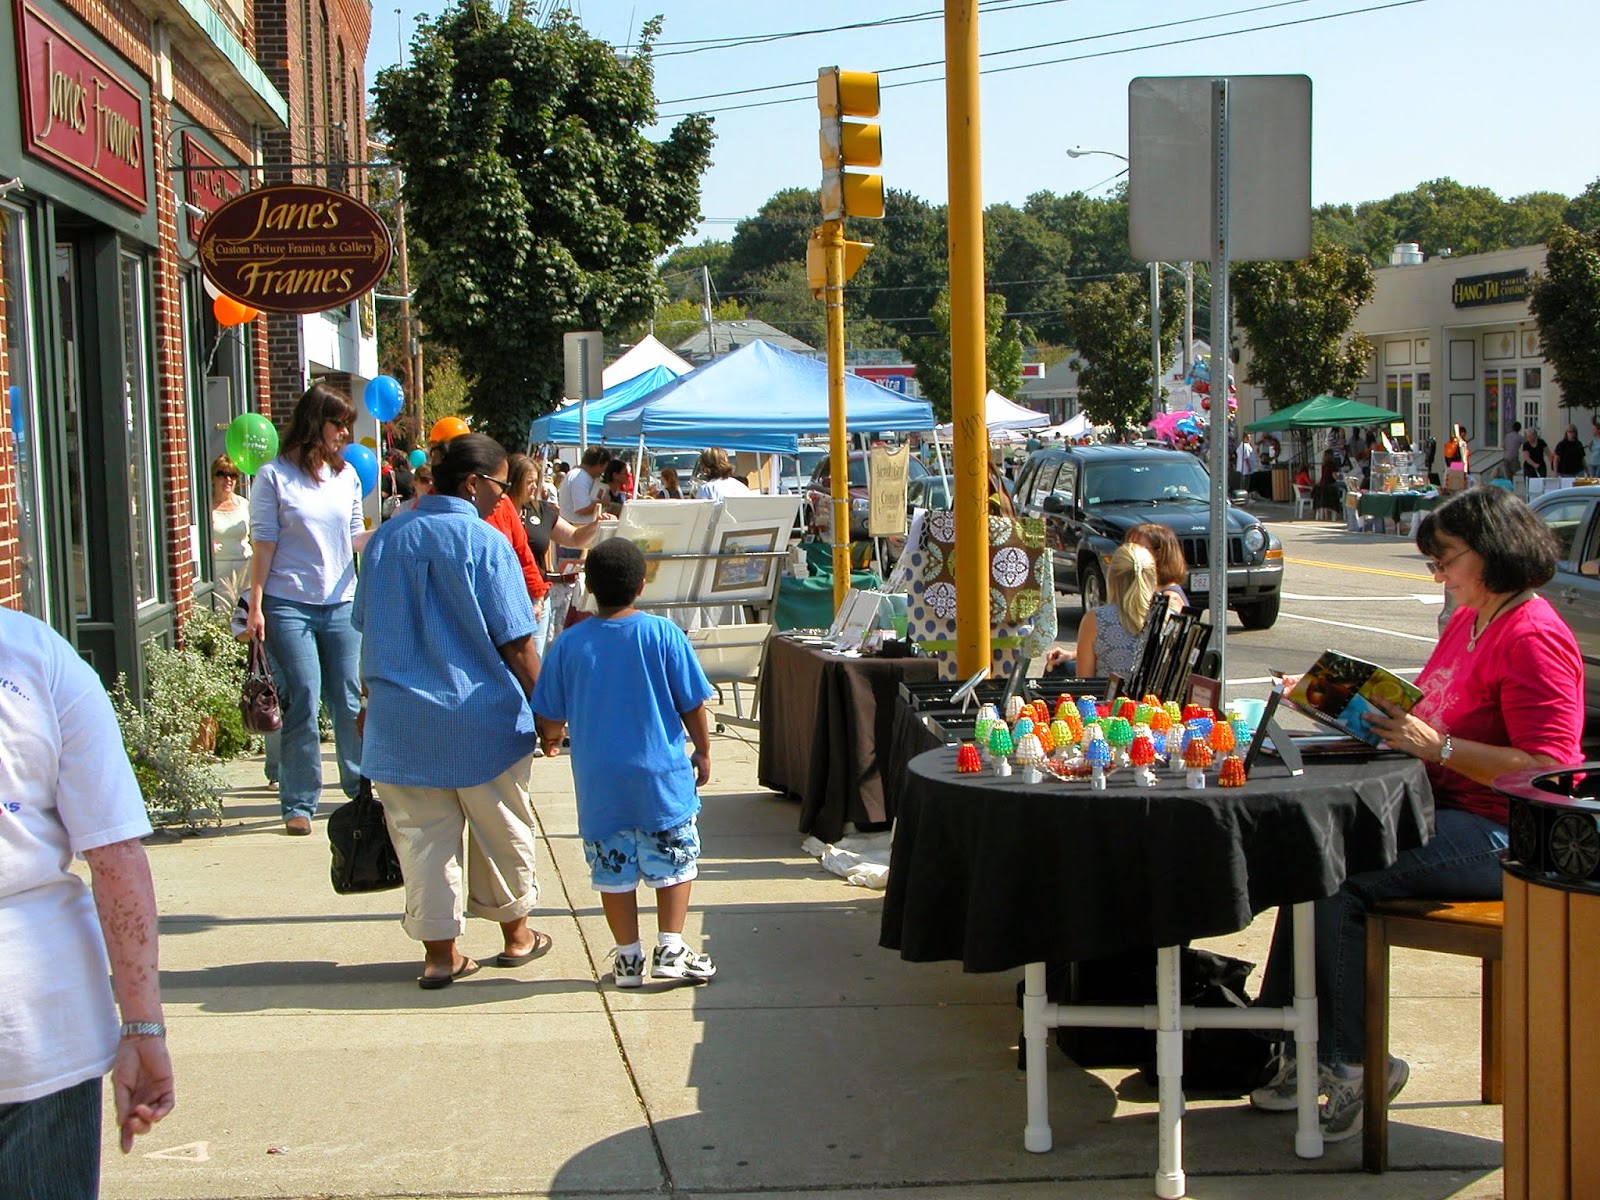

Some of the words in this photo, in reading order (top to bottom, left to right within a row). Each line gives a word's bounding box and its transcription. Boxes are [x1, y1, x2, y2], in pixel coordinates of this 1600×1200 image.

[36, 37, 88, 138] Jane's
[90, 76, 140, 168] Frames
[226, 196, 342, 245] Jane's
[215, 244, 250, 255] Custom
[253, 243, 286, 254] Picture
[288, 241, 326, 255] Framing
[328, 242, 336, 251] &
[339, 240, 373, 254] Gallery
[236, 253, 355, 297] Frames
[1454, 283, 1483, 303] HANG
[1484, 280, 1499, 299] TAI
